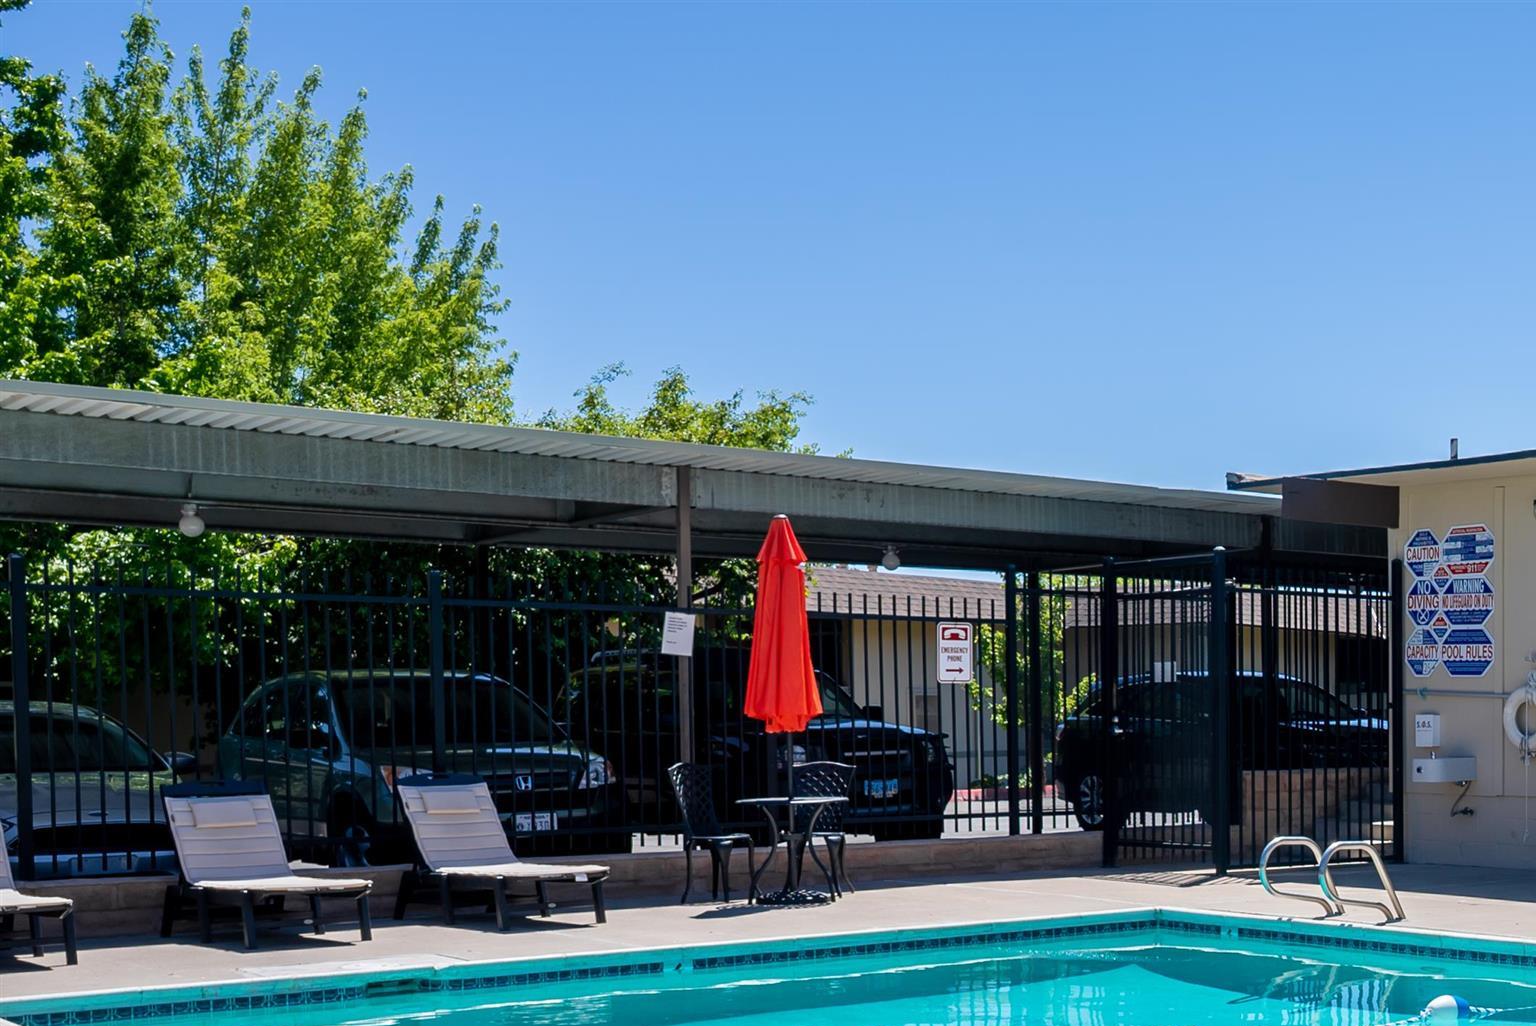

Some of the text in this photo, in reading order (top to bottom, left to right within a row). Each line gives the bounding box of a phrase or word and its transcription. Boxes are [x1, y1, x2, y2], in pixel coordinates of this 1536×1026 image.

[1407, 546, 1440, 561] CAUTION
[1467, 564, 1478, 573] 911
[1417, 581, 1431, 594] NO
[1453, 579, 1485, 594] WARNING
[1407, 595, 1439, 609] DIVING
[1442, 594, 1494, 608] NO LIFEGUARD ON DUTY
[941, 646, 968, 654] EMERGENCY
[1407, 645, 1438, 659] CAPACITY
[1442, 645, 1493, 659] POOL RULES
